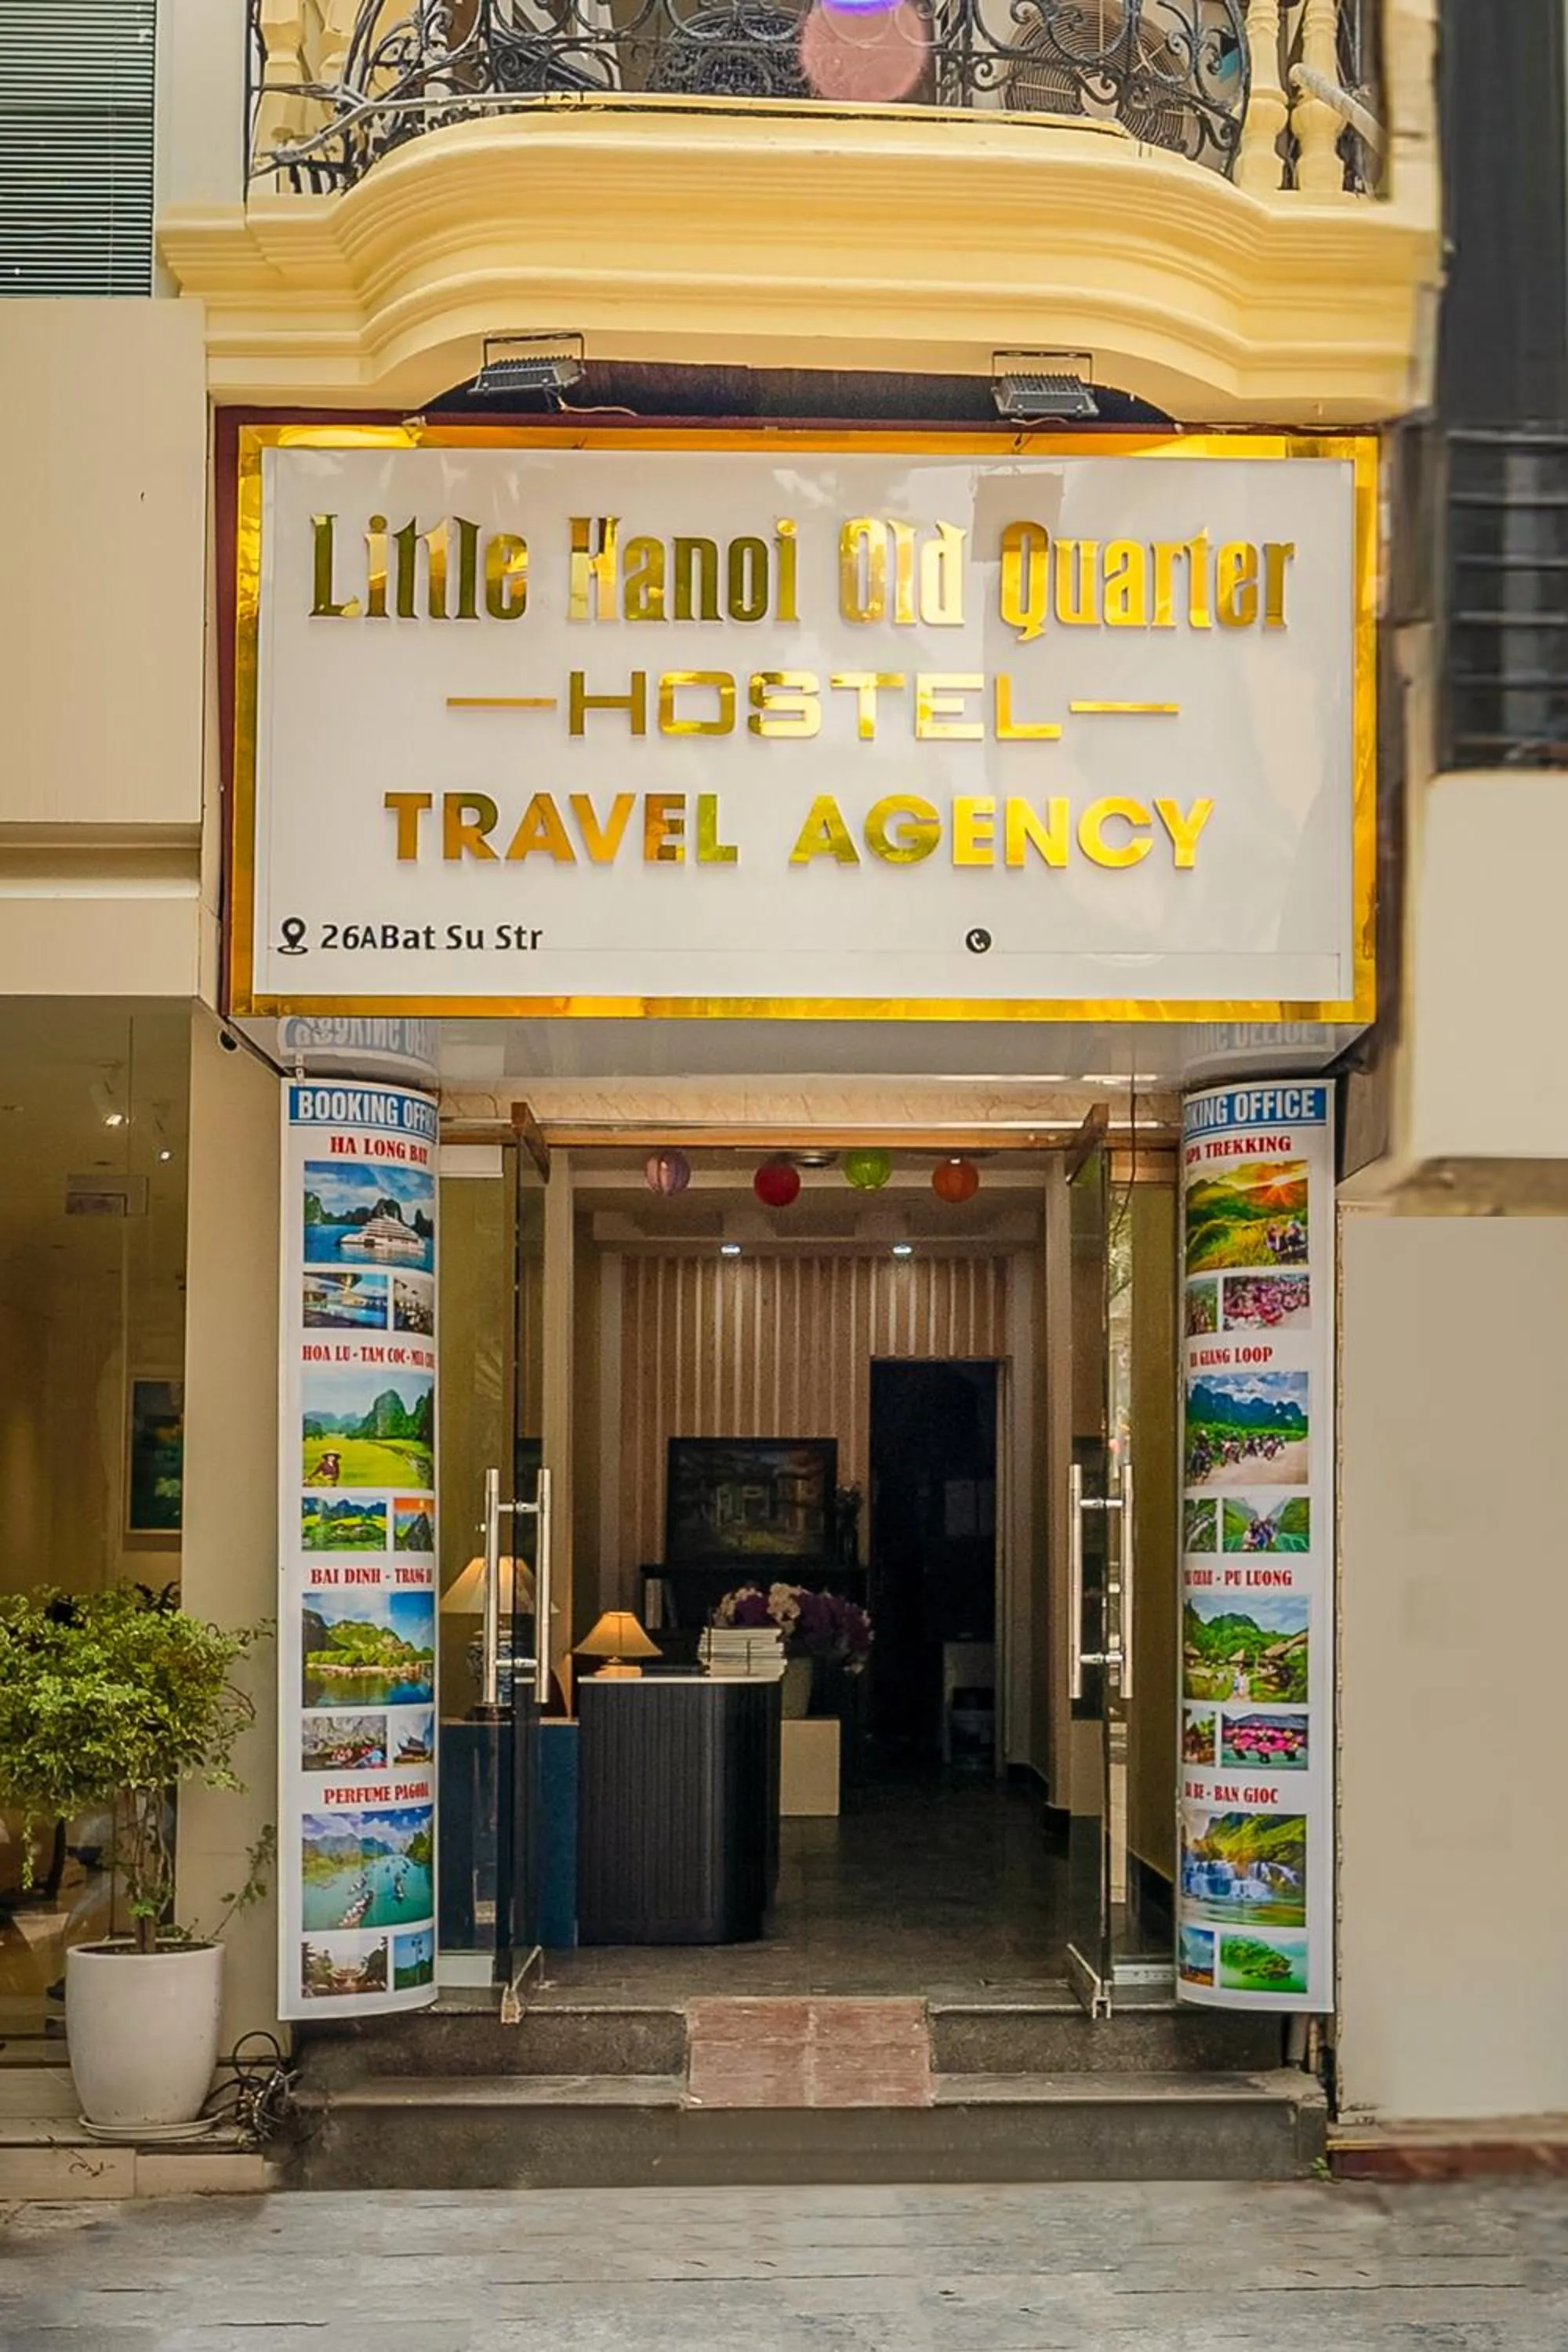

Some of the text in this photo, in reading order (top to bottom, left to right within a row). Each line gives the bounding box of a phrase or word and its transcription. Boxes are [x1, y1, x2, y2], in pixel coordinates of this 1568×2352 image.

[308, 514, 1295, 642] Little Hanoi Old Quarter
[568, 671, 1062, 740] HOSTEL
[383, 792, 1215, 869] TRAVEL AGENCY
[446, 924, 484, 950] Su
[495, 924, 543, 950] Str
[298, 1091, 398, 1125] BOOKING
[1234, 1090, 1316, 1122] OFFICE
[330, 1136, 356, 1154] HA
[363, 1138, 405, 1159] LONG
[1204, 1136, 1291, 1158] TREKKING
[302, 1345, 331, 1362] HOA
[336, 1345, 350, 1361] LU
[360, 1346, 384, 1363] TAM
[1235, 1346, 1273, 1363] LOOP
[310, 1568, 339, 1584] BAI
[344, 1568, 380, 1584] DINH
[1225, 1570, 1242, 1585] PU
[1246, 1570, 1292, 1585] LUONG
[324, 1786, 392, 1804] PERFUME
[1214, 1785, 1240, 1802] BAN
[1244, 1788, 1279, 1803] GIOC
